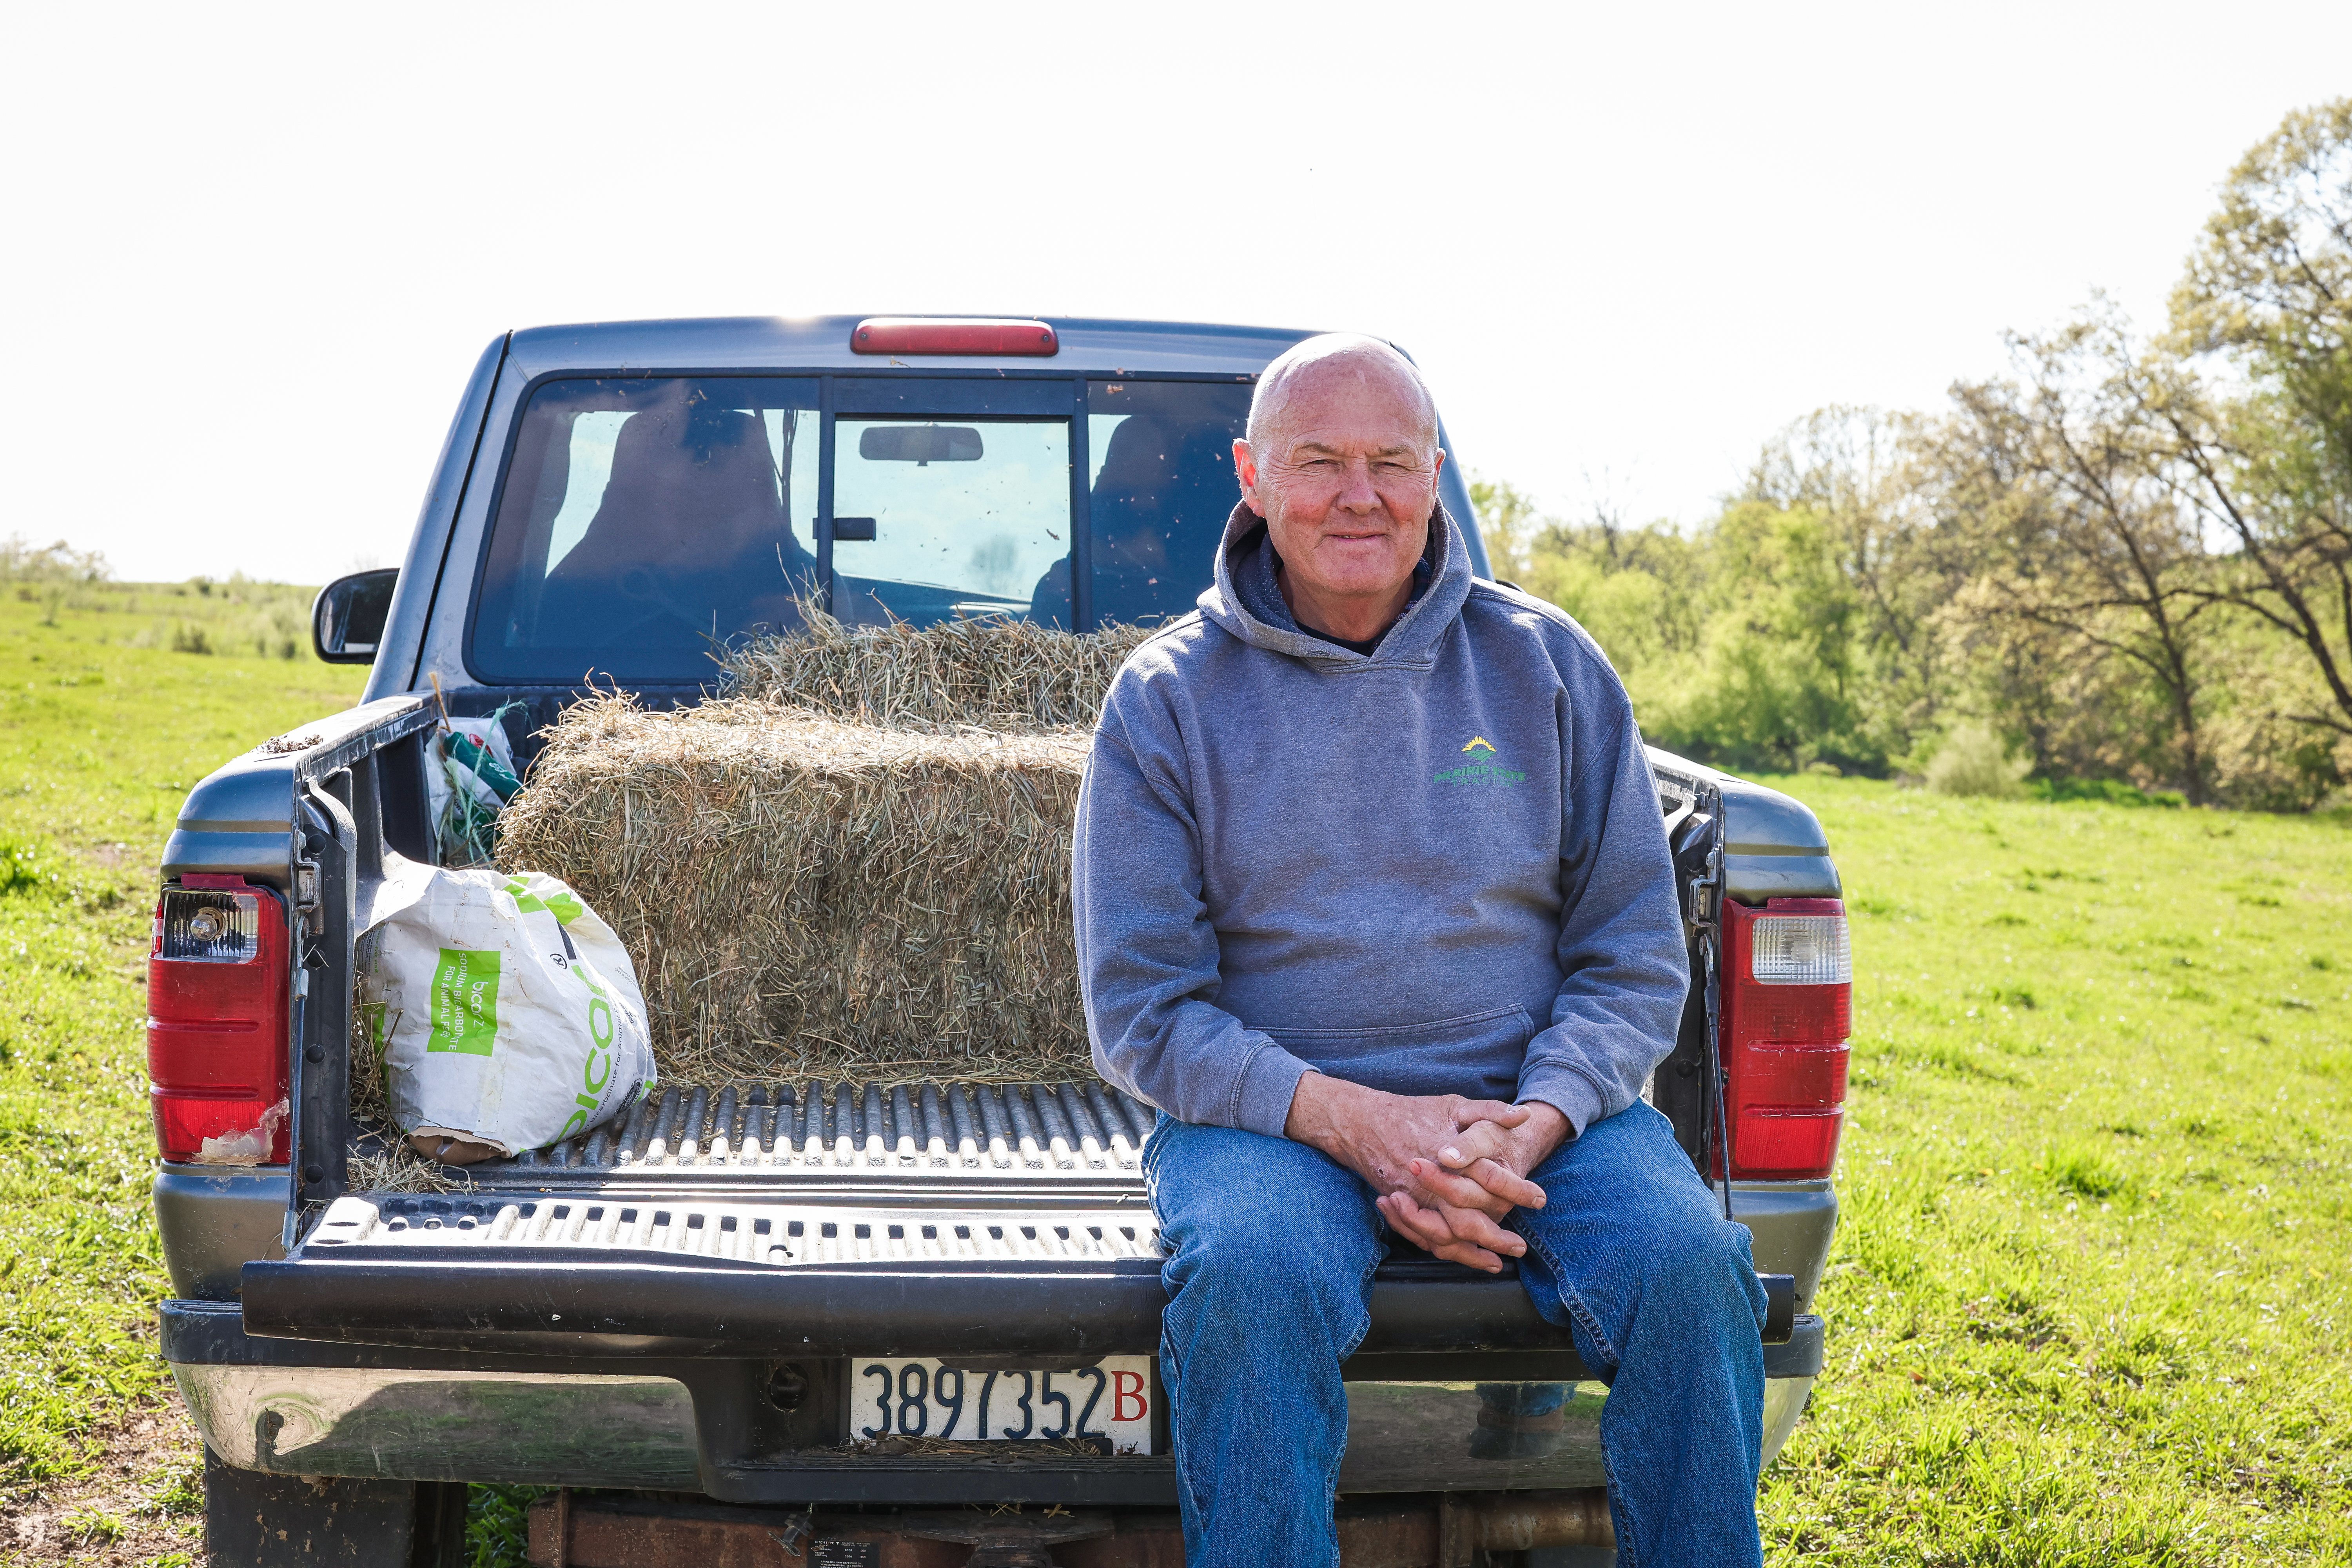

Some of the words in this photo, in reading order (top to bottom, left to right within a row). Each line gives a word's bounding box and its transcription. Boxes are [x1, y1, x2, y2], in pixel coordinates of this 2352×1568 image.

[1434, 765, 1489, 783] PRAIRIE
[1492, 766, 1526, 781] STATE
[1451, 776, 1513, 788] TRACTOR
[443, 966, 456, 981] FOR
[454, 953, 467, 987] SODIUM
[441, 982, 450, 1019] ANIMAL
[440, 1021, 450, 1038] FEED
[862, 1364, 1106, 1440] 3897352
[1111, 1371, 1147, 1421] B
